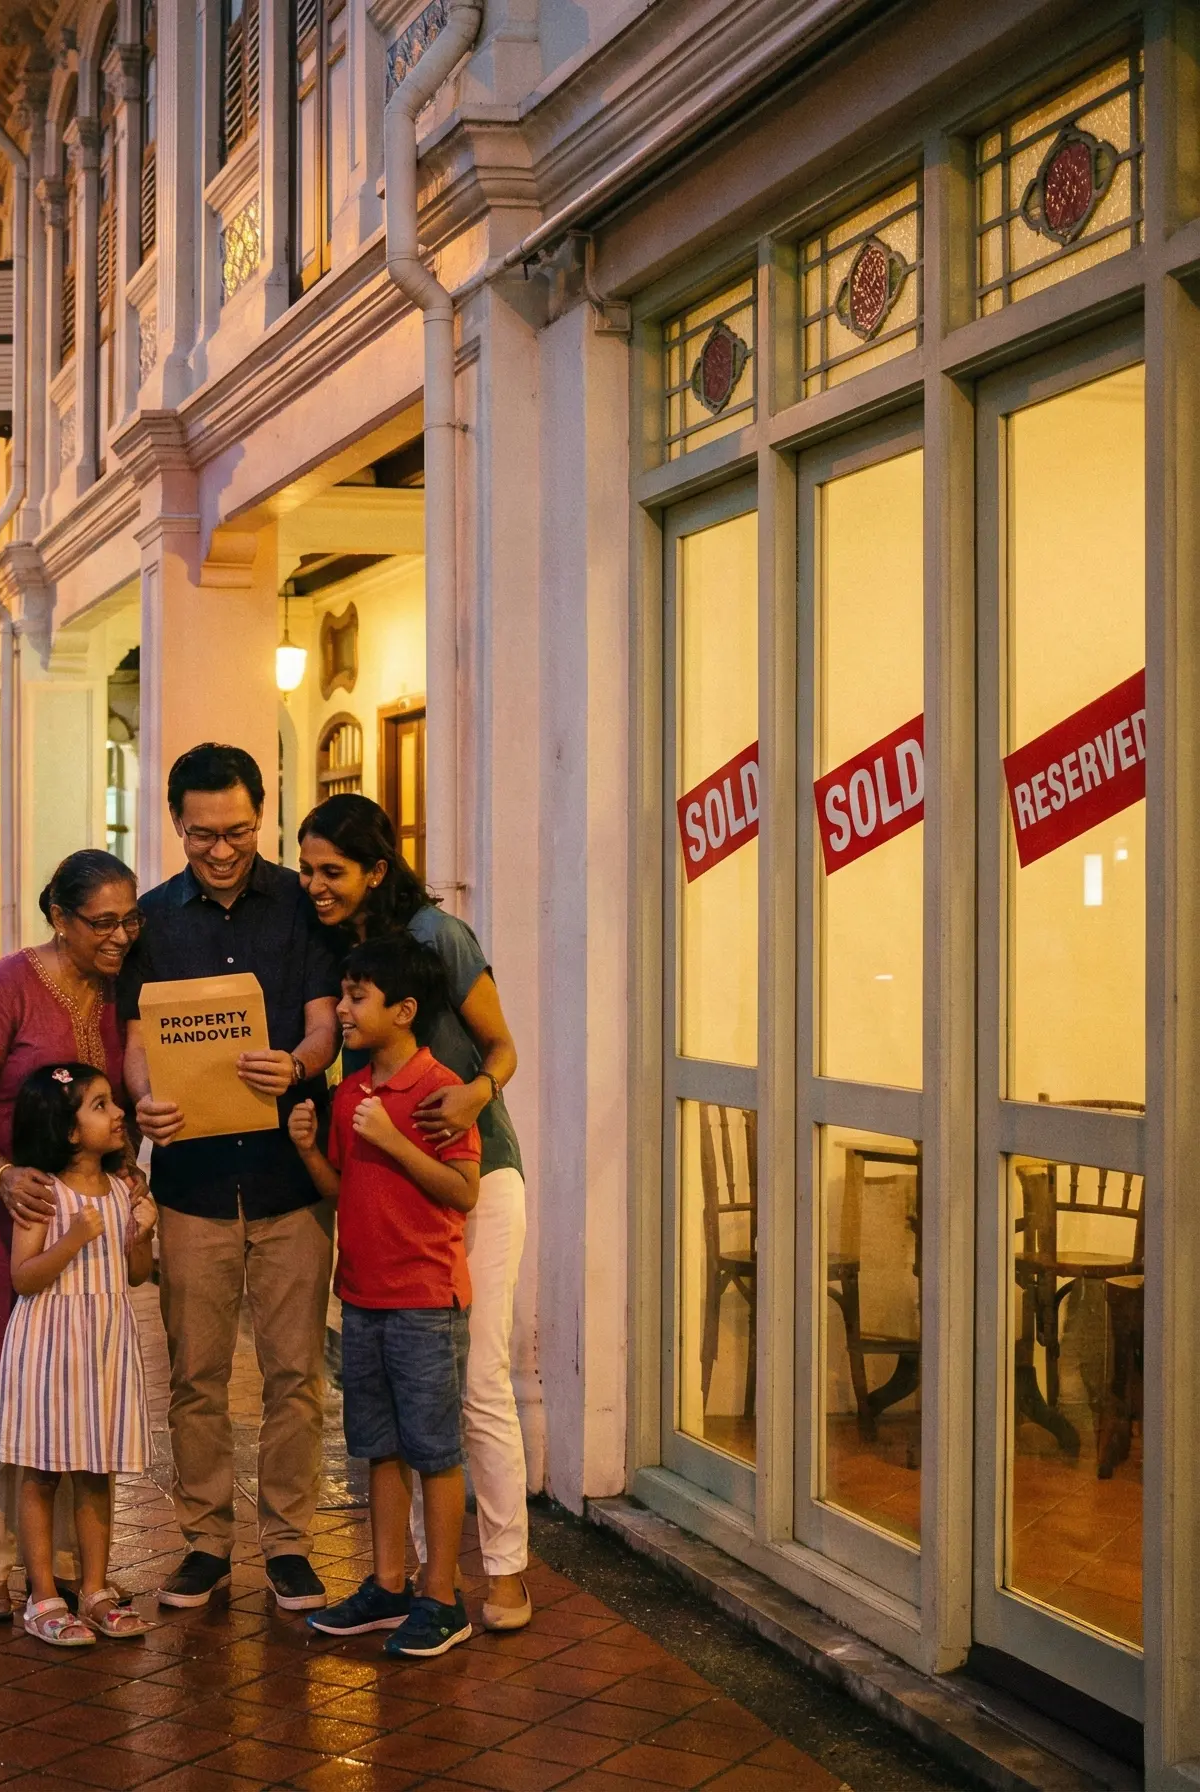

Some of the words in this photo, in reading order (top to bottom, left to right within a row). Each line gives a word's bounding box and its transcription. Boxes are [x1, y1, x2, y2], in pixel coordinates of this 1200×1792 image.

[685, 760, 760, 863] SOLD
[825, 738, 925, 853] SOLD
[160, 1010, 248, 1029] PROPERTY
[160, 1026, 252, 1045] HANDOVER
